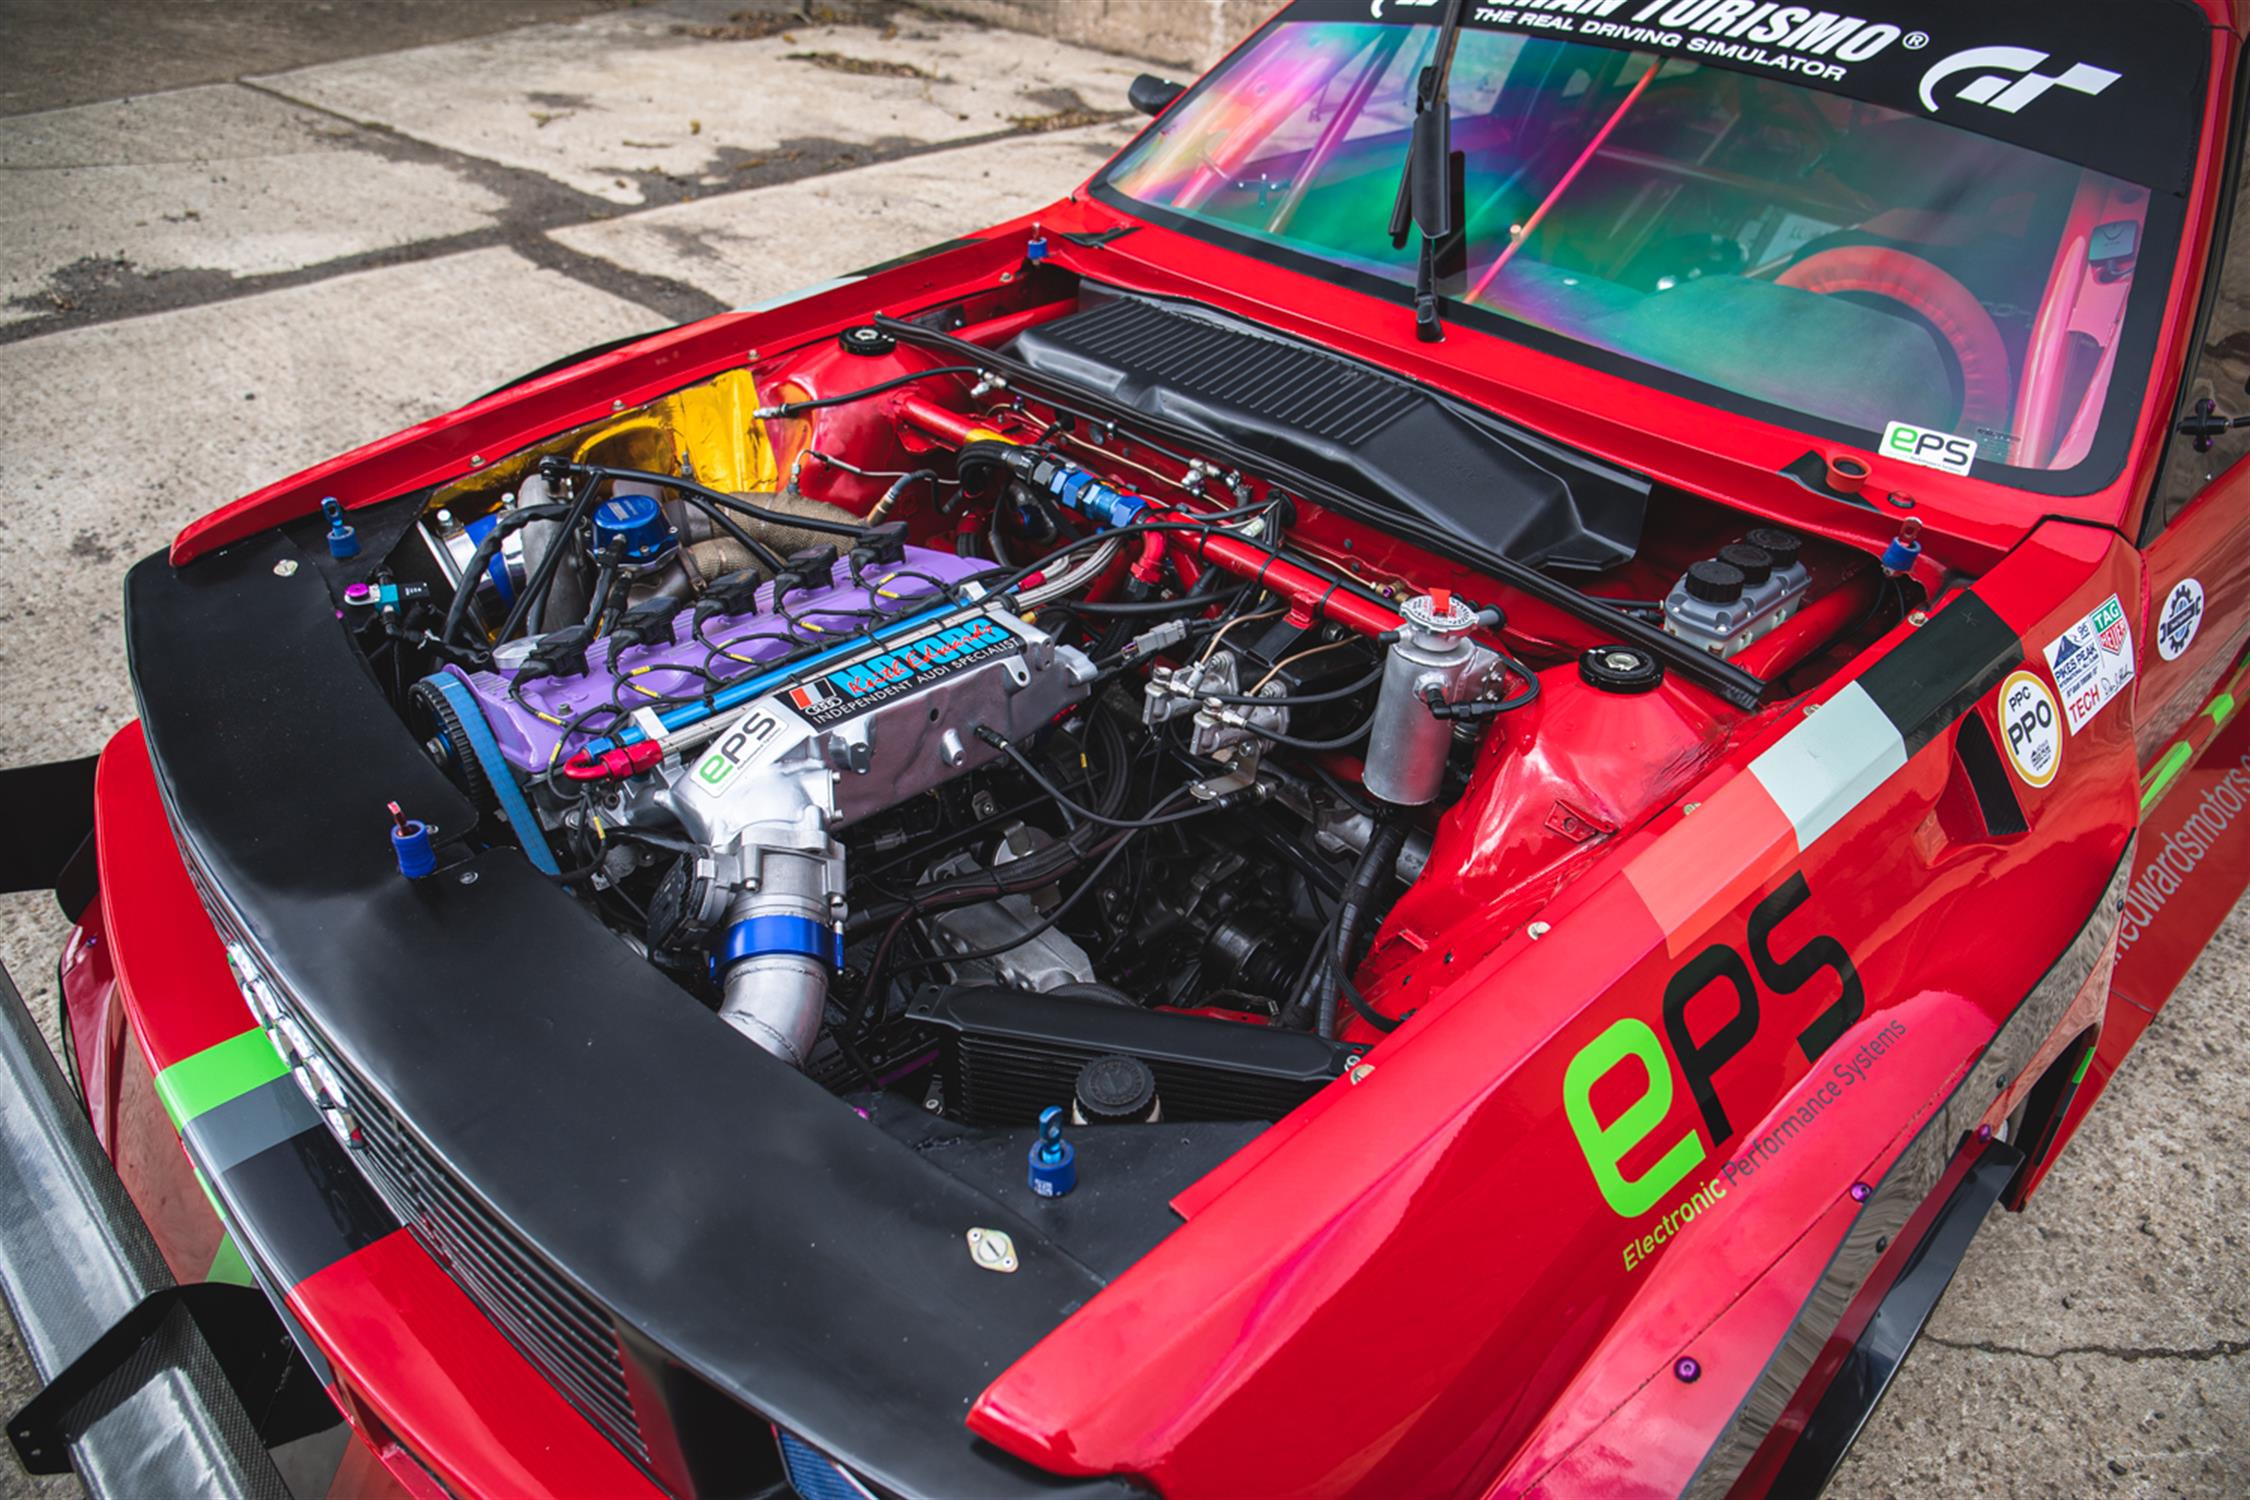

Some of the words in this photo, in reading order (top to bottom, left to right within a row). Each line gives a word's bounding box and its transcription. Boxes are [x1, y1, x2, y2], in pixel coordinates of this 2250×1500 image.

[1473, 7, 1518, 24] THE
[1517, 12, 1574, 31] REAL
[1579, 20, 1682, 48] DRIVING
[1686, 37, 1847, 82] SIMULATOR
[2094, 601, 2119, 630] TAG
[812, 682, 914, 725] INDEPENDENT
[917, 666, 950, 684] AUDI
[954, 637, 1021, 669] SPECIALIST
[847, 659, 907, 695] Keith
[906, 624, 993, 668] Edwards
[2054, 658, 2078, 681] PIKES
[2075, 643, 2098, 665] PEAK
[2008, 699, 2052, 755] PPO
[2009, 686, 2031, 712] PPC
[2068, 684, 2100, 723] TECH
[1622, 1176, 1728, 1273] Electronic
[1721, 1081, 1843, 1188] Performance
[1835, 1017, 1908, 1086] Systems
